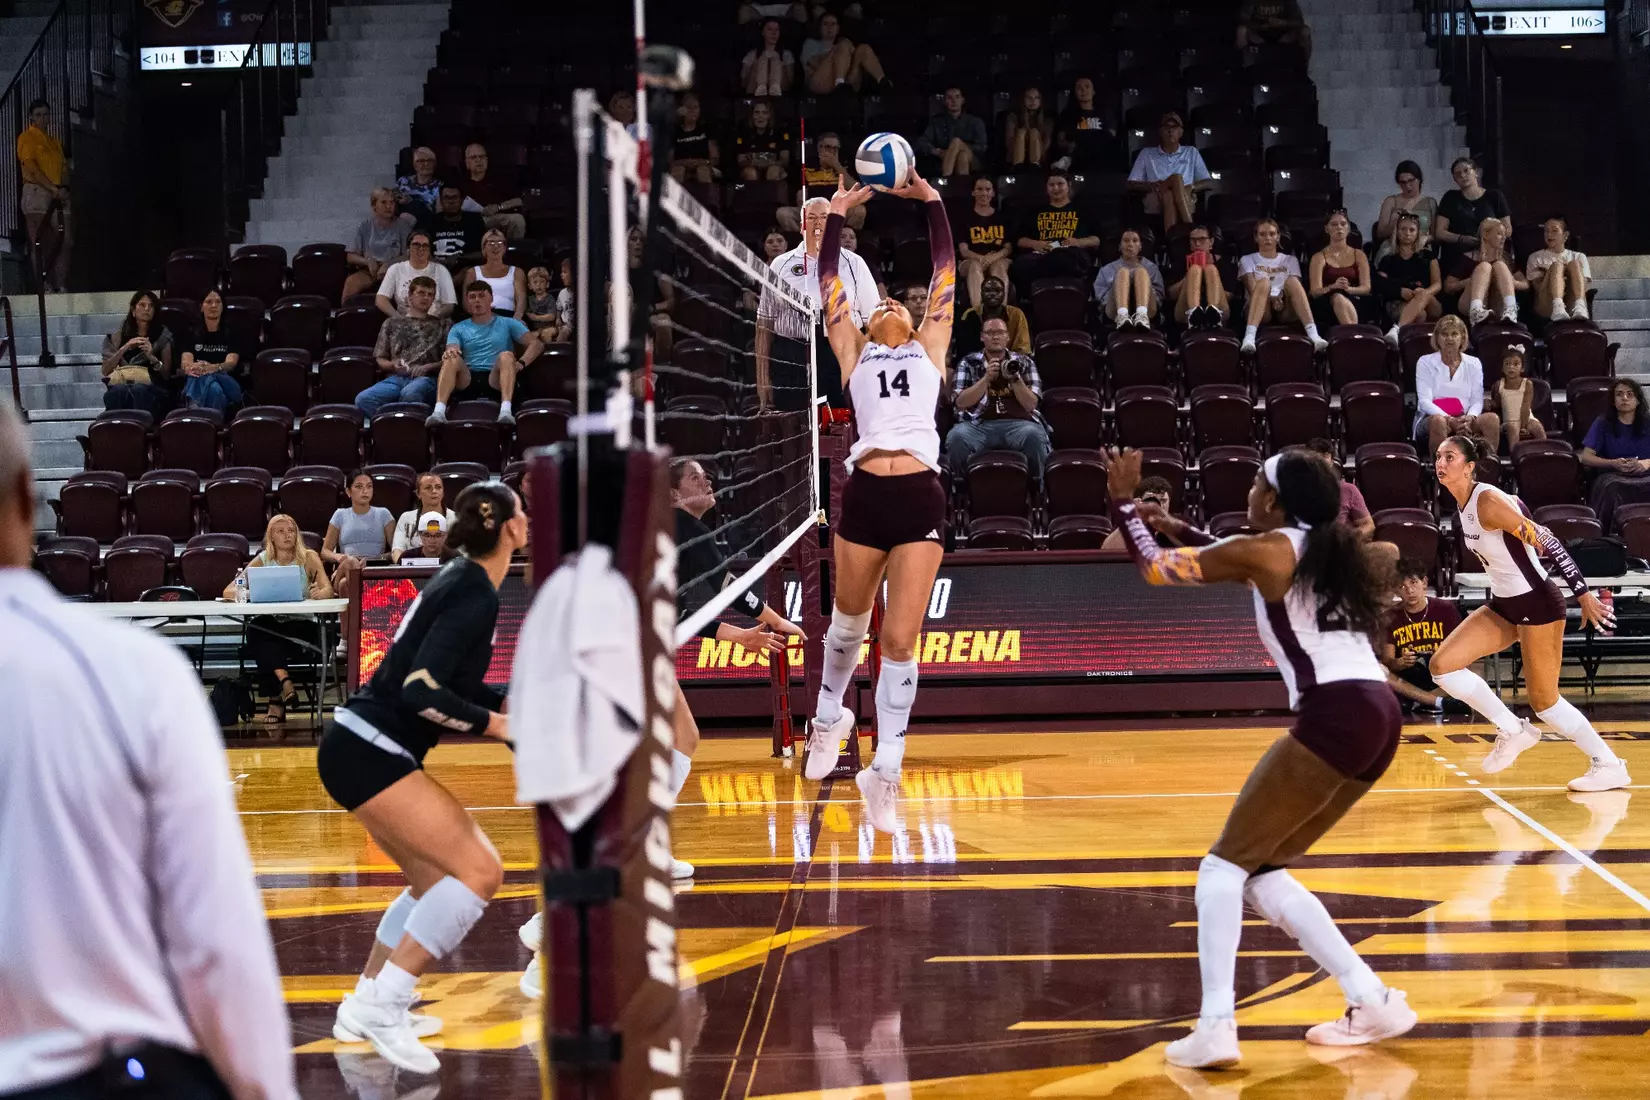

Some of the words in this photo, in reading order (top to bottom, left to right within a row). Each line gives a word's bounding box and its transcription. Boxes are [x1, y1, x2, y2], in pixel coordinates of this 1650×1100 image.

[1509, 16, 1551, 28] EXIT
[1571, 16, 1593, 27] 106
[155, 52, 176, 63] 104
[1037, 211, 1079, 220] CENTRAL
[1037, 220, 1078, 231] MICHIGAN
[970, 225, 1004, 240] CMU
[877, 369, 910, 398] 14
[1537, 531, 1579, 578] CHIPPEWAS
[643, 530, 679, 986] MICHIGAN
